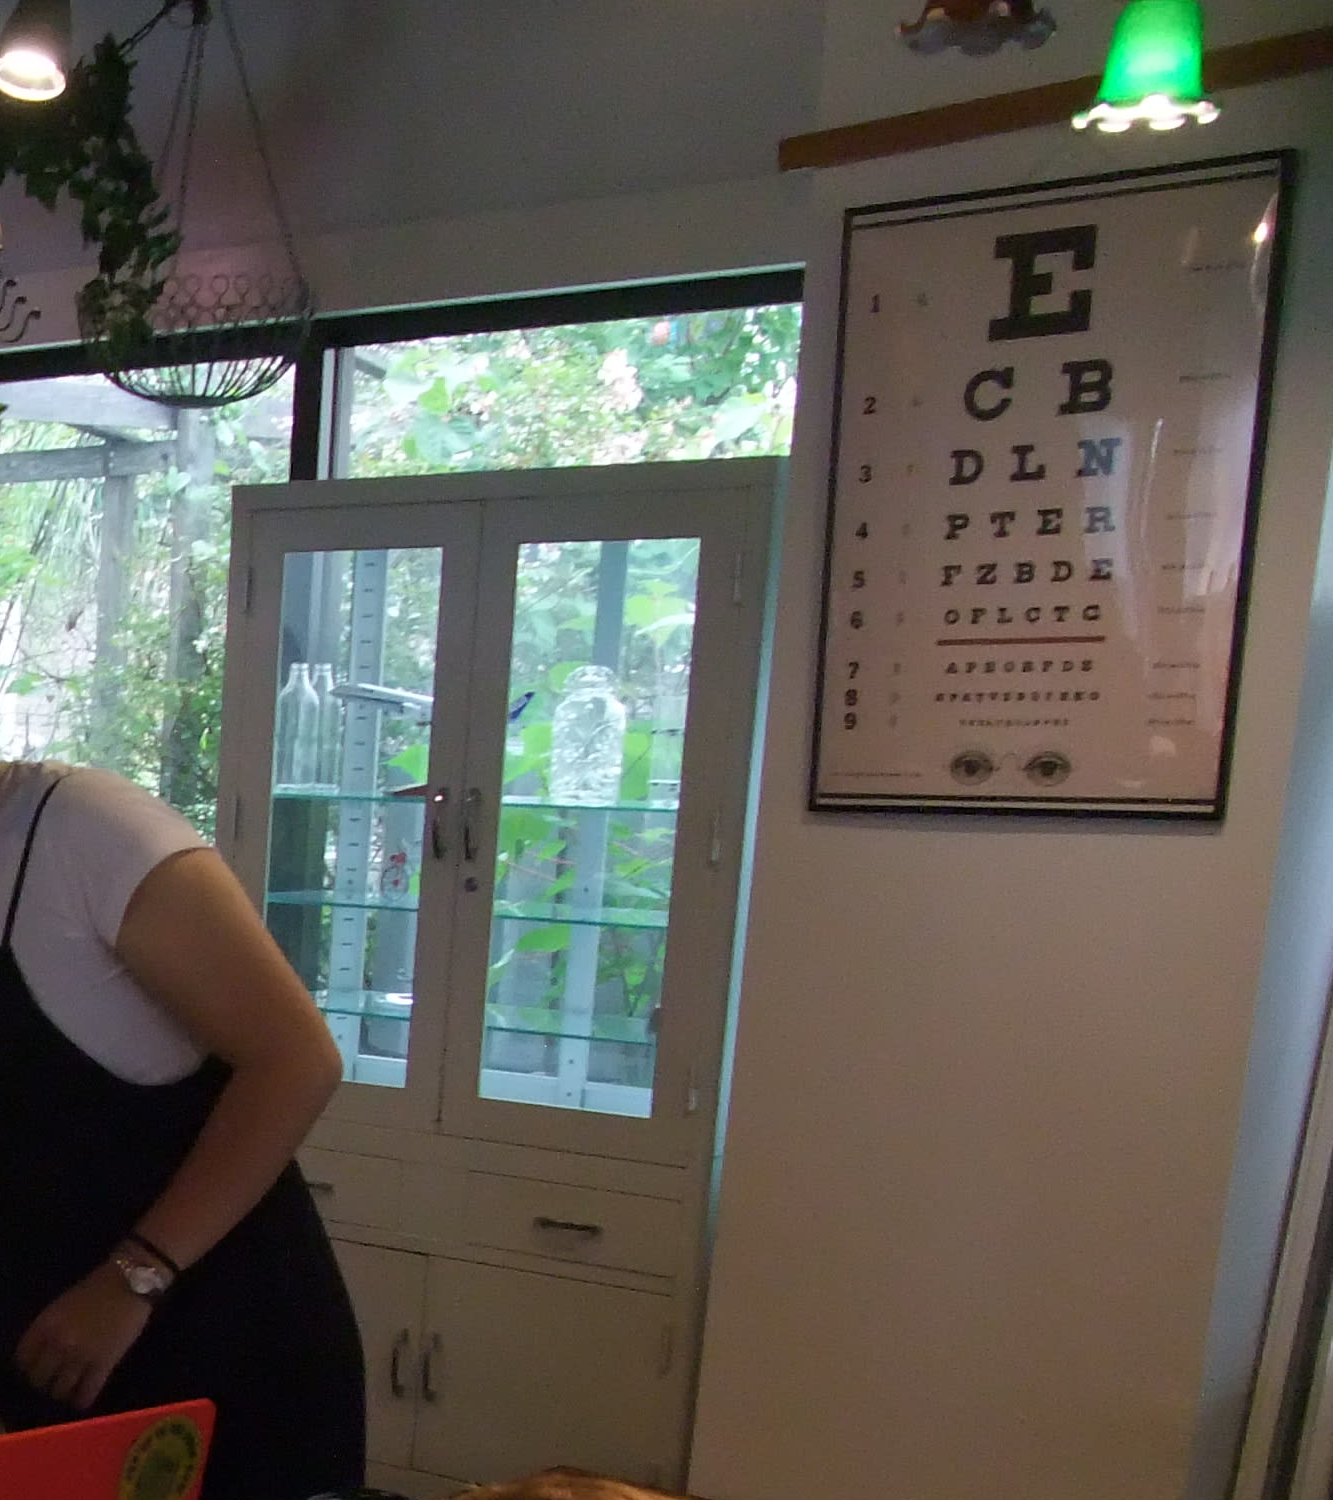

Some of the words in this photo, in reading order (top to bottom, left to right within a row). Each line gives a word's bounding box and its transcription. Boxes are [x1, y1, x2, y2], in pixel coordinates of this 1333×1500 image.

[987, 223, 1099, 343] E
[869, 293, 881, 314] 1
[963, 365, 1015, 422] C
[1054, 358, 1114, 417] B
[862, 395, 878, 415] 2
[858, 463, 873, 484] 3
[854, 521, 869, 541] 4
[851, 569, 866, 589] 5
[849, 610, 864, 631] 6
[848, 661, 860, 680] 7
[844, 688, 859, 707] 8
[843, 711, 858, 731] 9
